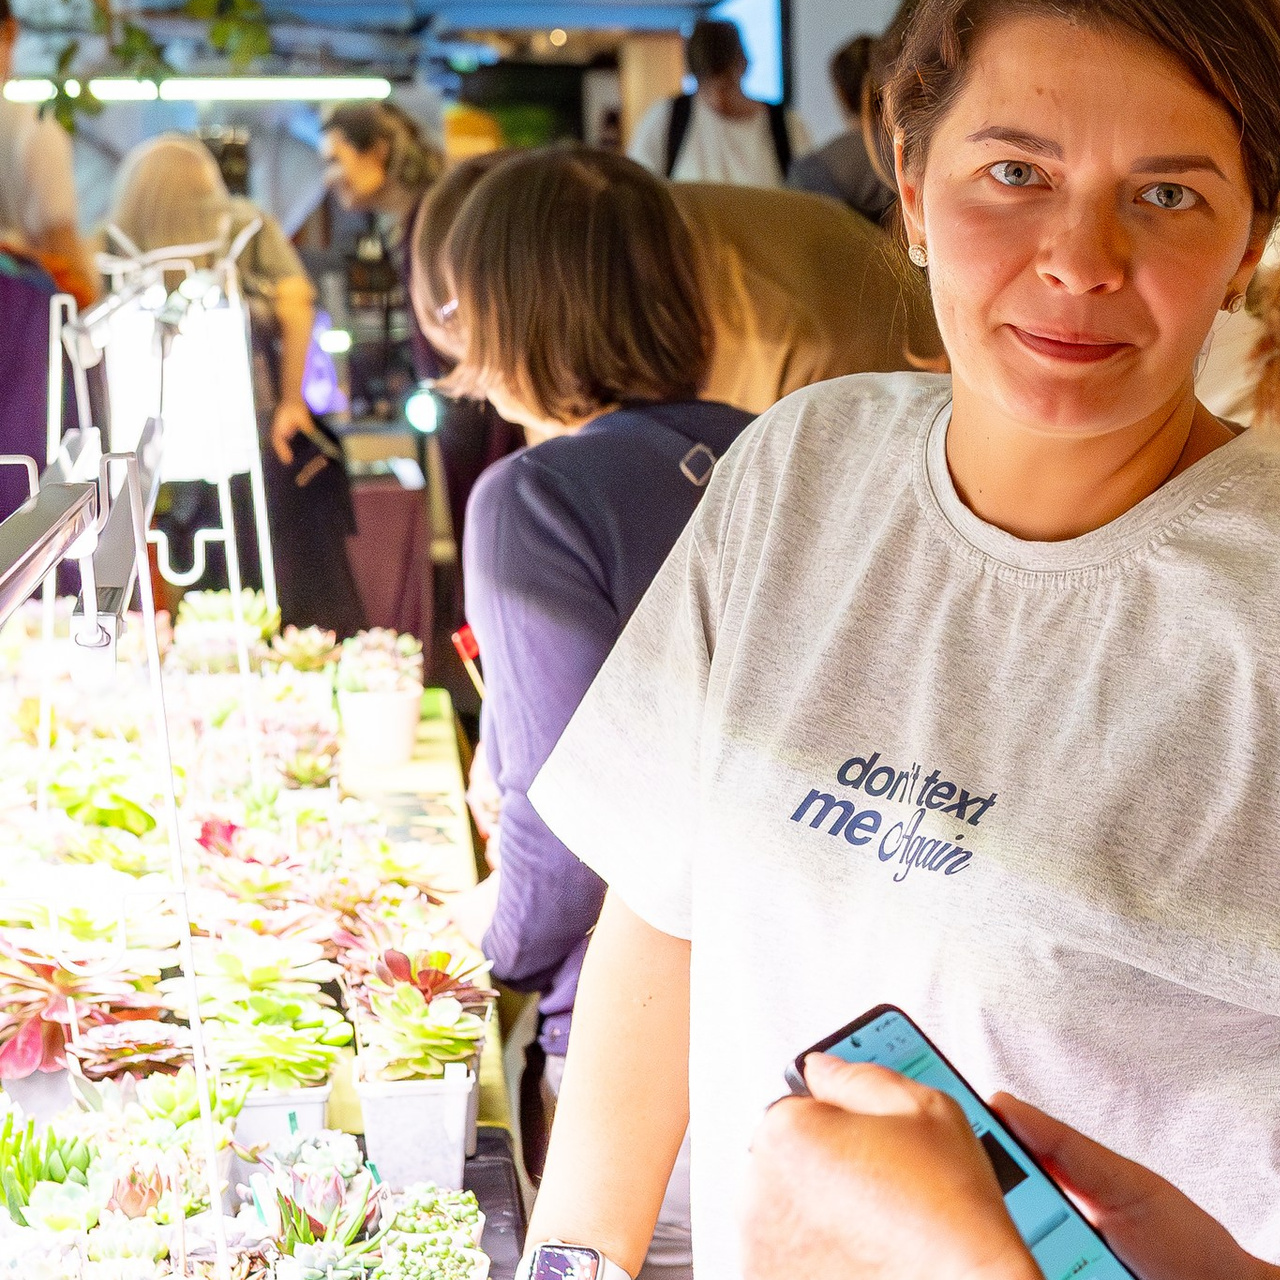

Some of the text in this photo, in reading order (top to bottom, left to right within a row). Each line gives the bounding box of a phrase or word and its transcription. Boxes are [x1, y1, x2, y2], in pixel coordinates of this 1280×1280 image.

[836, 751, 998, 826] don't text
[790, 788, 973, 882] me Again
